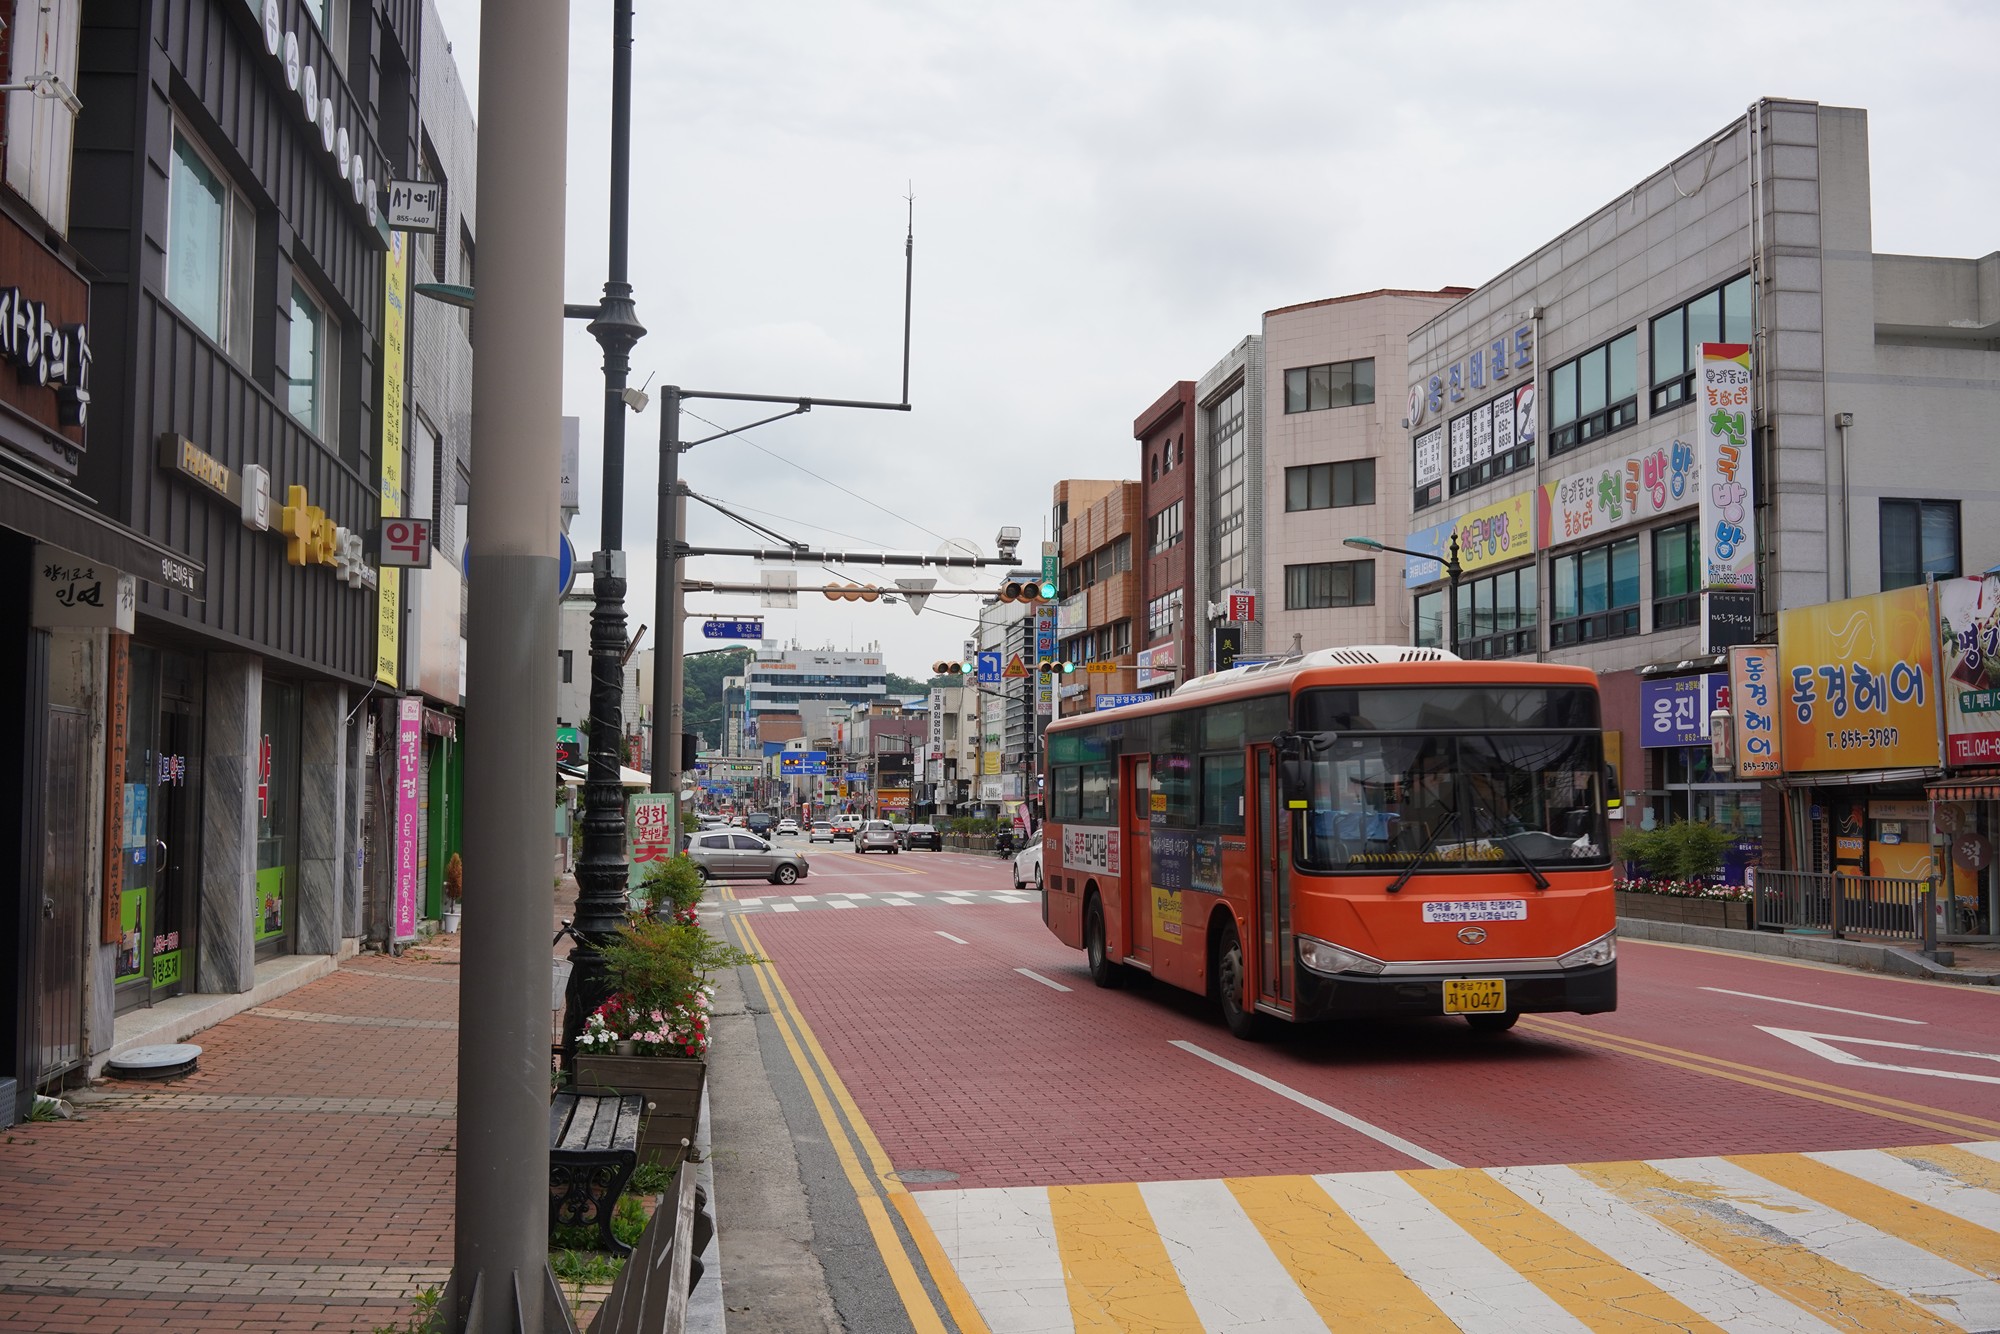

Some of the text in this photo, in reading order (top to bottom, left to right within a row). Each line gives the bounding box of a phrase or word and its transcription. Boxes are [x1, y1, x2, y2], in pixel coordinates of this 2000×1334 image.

[393, 188, 436, 212] 서예
[396, 214, 430, 224] 855-4407
[1428, 326, 1532, 413] 웅진태권도
[1706, 369, 1748, 384] 우리동네
[1707, 386, 1748, 406] 놀이터
[183, 441, 229, 493] PHARMACY
[1561, 476, 1593, 506] 우리동네
[1598, 440, 1695, 522] 천국방방
[1709, 408, 1747, 560] 천국방방
[1563, 499, 1593, 537] 놀이터
[386, 523, 427, 562] 약
[43, 564, 94, 582] 향기로운
[162, 559, 187, 587] 테이크아웃
[1709, 563, 1732, 572] 예약문의
[1710, 573, 1753, 585] 070-8858-1009
[56, 581, 104, 607] 인연
[1237, 596, 1249, 620] 편의점
[736, 624, 761, 632] 웅진로
[1711, 646, 1726, 654] 858
[979, 673, 1000, 681] 비보호
[1089, 663, 1114, 672] 신호준수
[1792, 659, 1925, 724] 동경헤어
[1743, 656, 1772, 756] 동경헤어
[1840, 728, 1898, 749] 855-3787
[402, 731, 418, 772] 빨간
[1743, 760, 1779, 771] 855-3787
[635, 805, 667, 826] 생화
[639, 826, 662, 842] 꽃다발
[402, 813, 413, 924] Cup Food Take-out
[1427, 900, 1522, 912] 승객을 가족처럼 친절하고
[1433, 911, 1518, 922] 안전하게 모시겠습니다
[1459, 981, 1488, 990] 충남 71
[1448, 992, 1501, 1008] 자 1047
